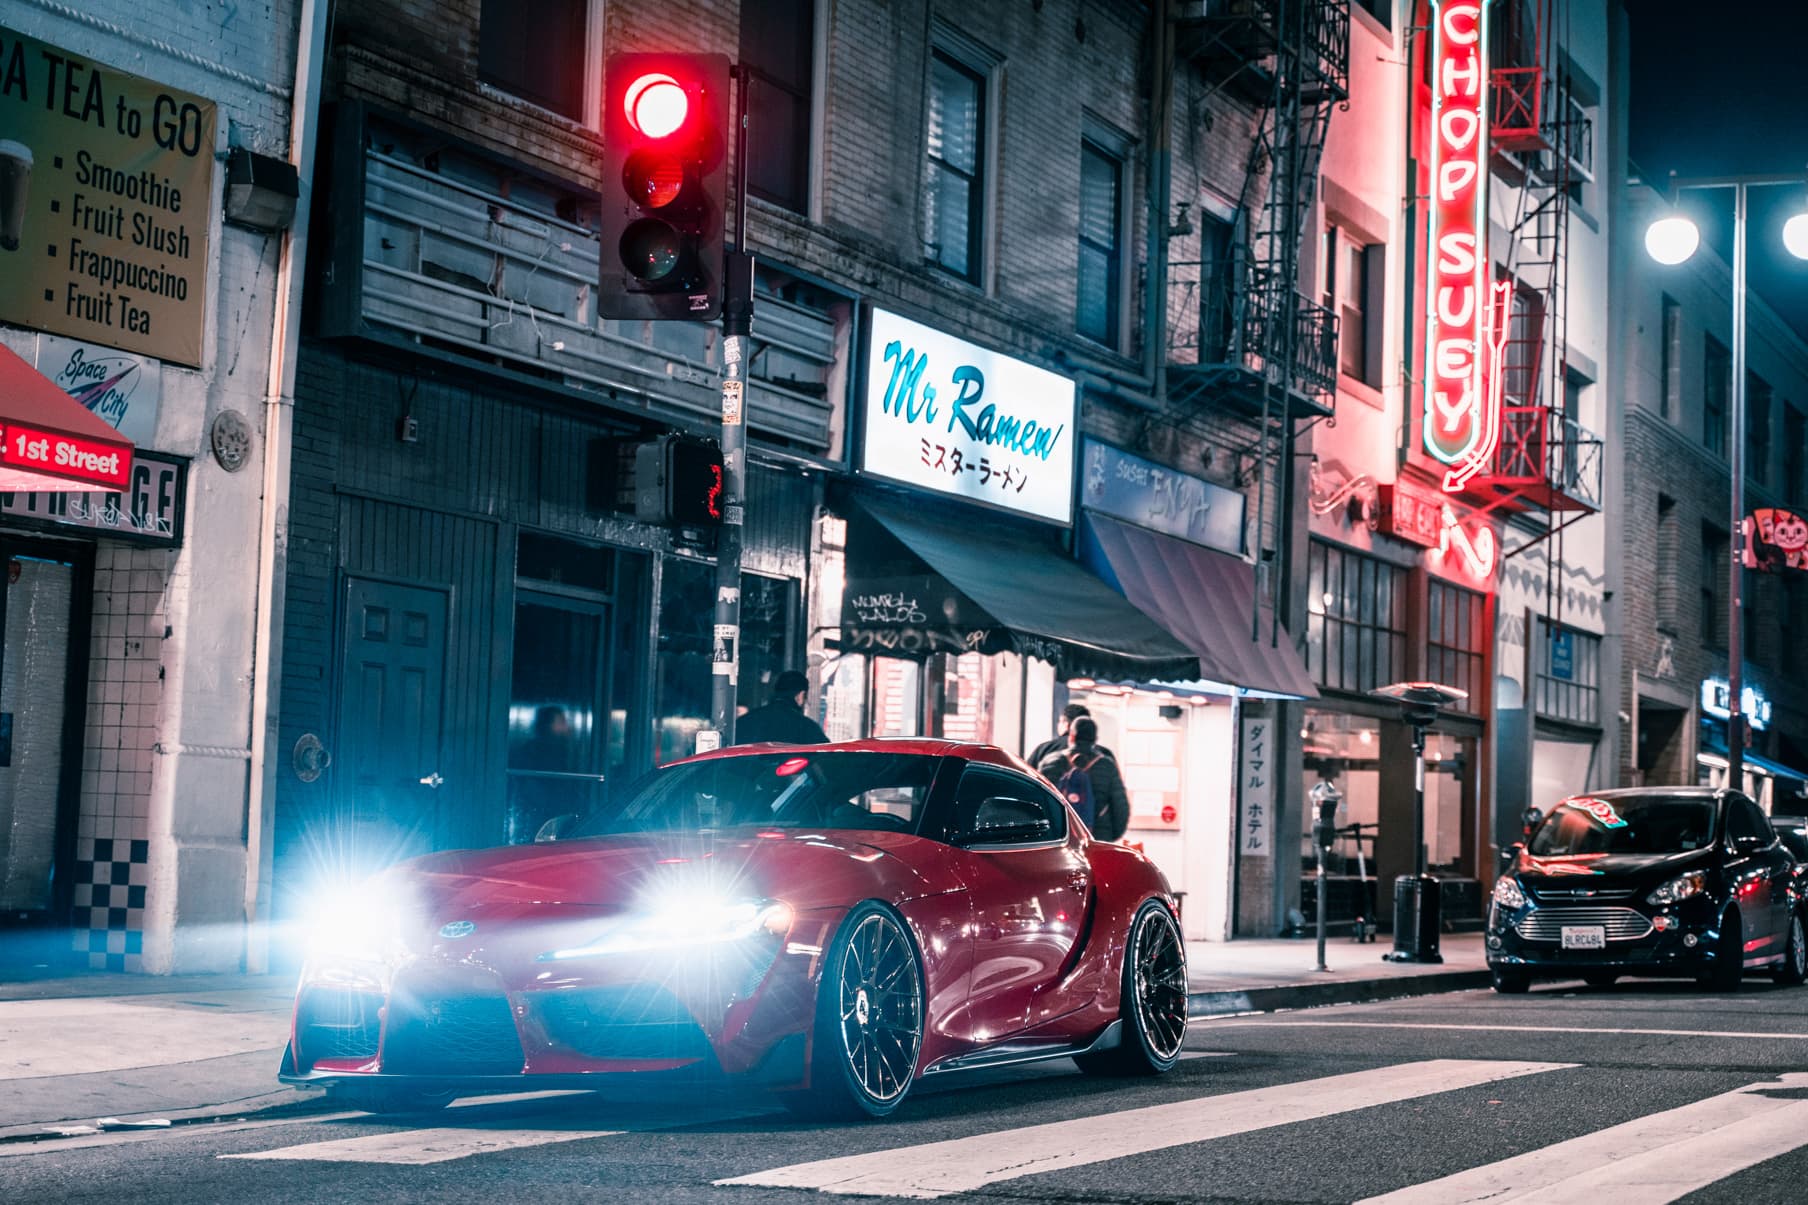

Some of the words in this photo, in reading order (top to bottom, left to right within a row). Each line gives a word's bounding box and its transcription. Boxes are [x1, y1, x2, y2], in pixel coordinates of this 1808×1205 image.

[0, 36, 28, 103] A
[43, 51, 105, 128] TEA
[116, 95, 141, 139] to
[152, 94, 201, 157] GO
[1439, 4, 1480, 201] CHOP
[76, 150, 181, 213] Smoothie
[72, 193, 124, 241] Fruit
[132, 212, 189, 259] Slush
[69, 238, 187, 301] Frappuccino
[66, 283, 112, 327] Fruit
[119, 295, 150, 335] Tea
[1434, 232, 1476, 431] SUEY
[65, 348, 107, 385] Space
[101, 388, 129, 429] City
[883, 340, 938, 424] Mr
[947, 365, 1064, 461] Ramen
[16, 434, 50, 462] 1st
[55, 441, 119, 475] Street
[921, 438, 1027, 493] ミスターラーメン
[1248, 725, 1265, 789] ダイマル
[1247, 803, 1264, 849] ホテル
